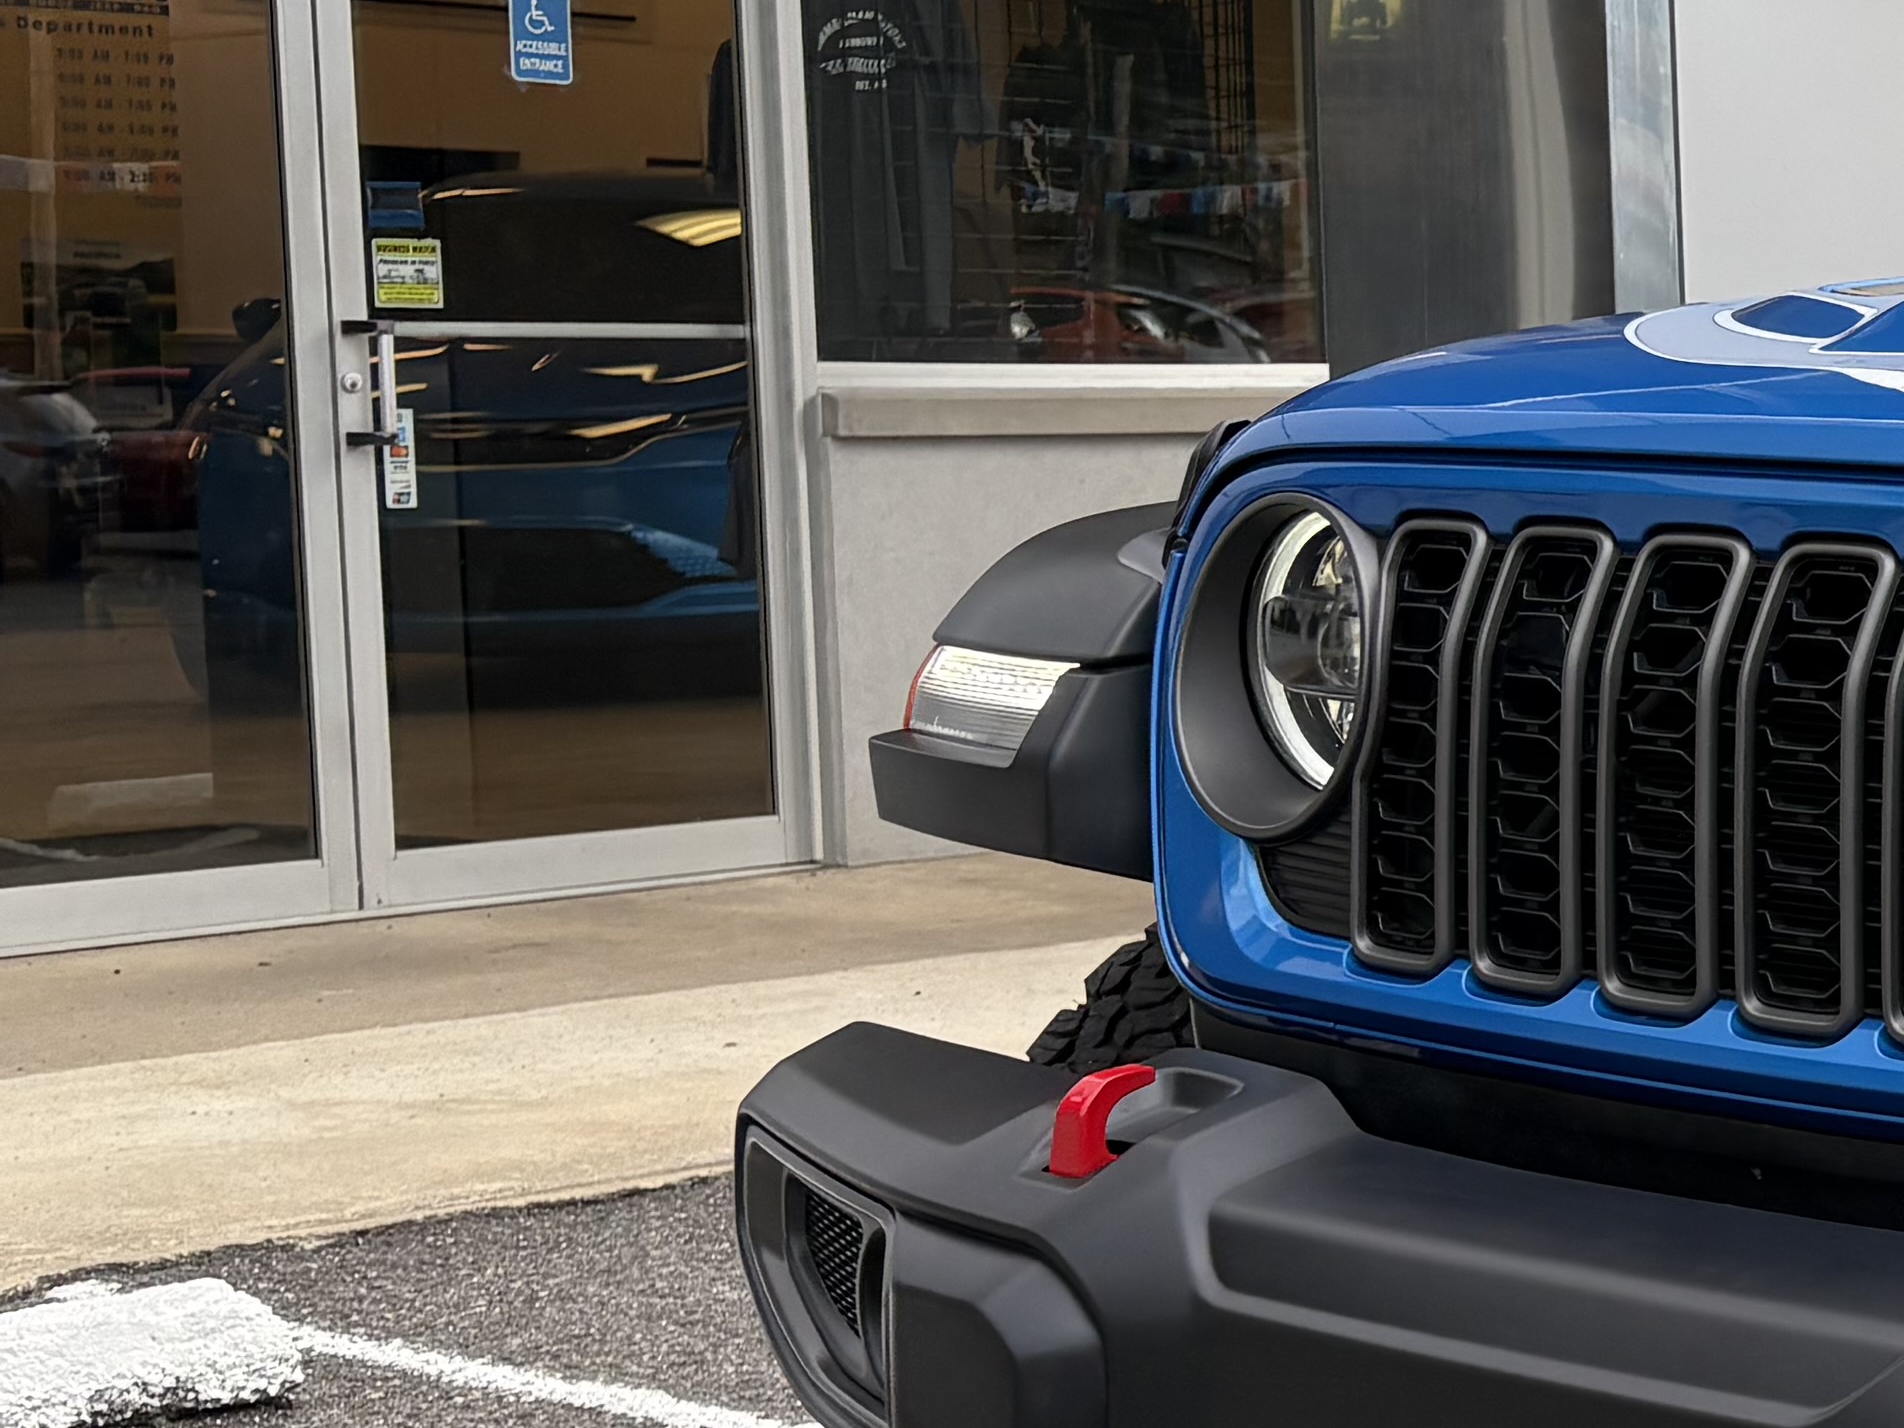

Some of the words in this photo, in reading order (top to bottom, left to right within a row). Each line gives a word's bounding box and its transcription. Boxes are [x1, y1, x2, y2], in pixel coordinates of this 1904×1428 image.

[16, 15, 154, 38] Department
[516, 39, 568, 57] ACCESSIBLE
[519, 57, 565, 74] ENTRANCE
